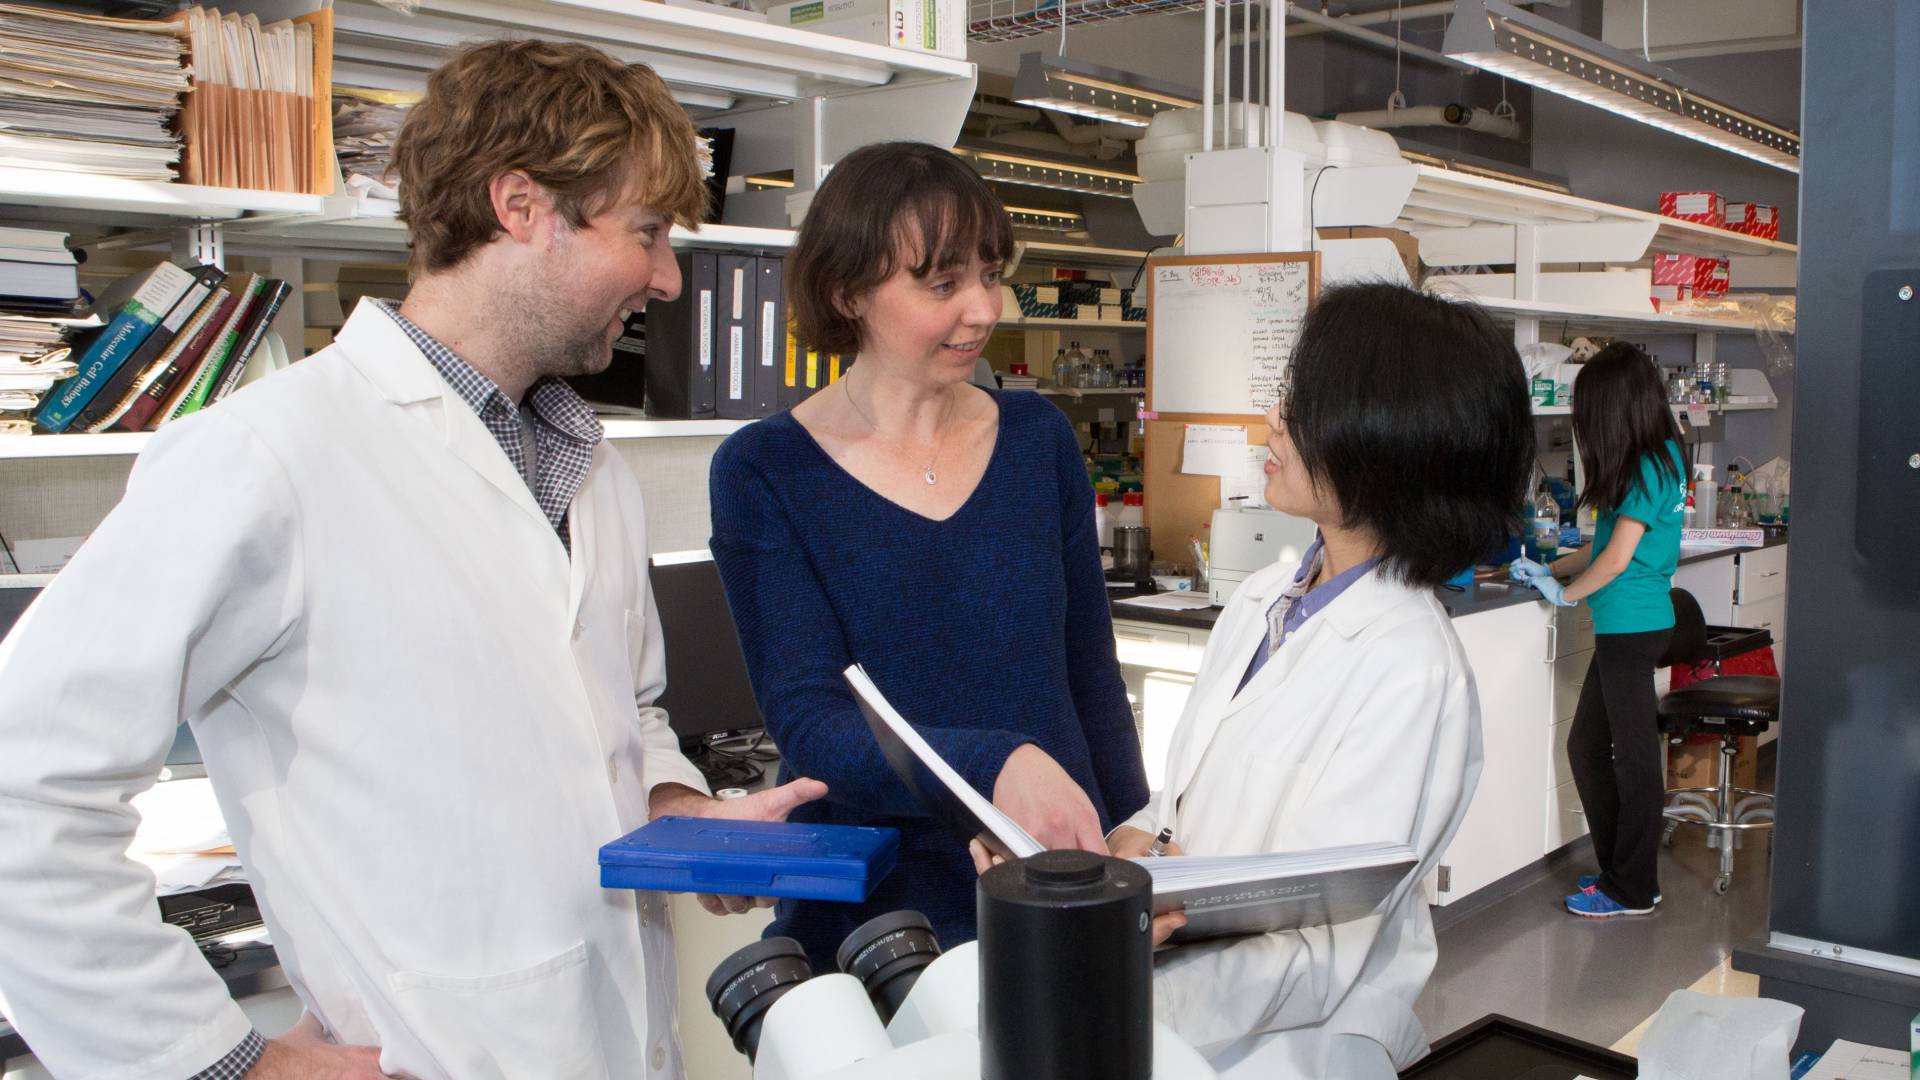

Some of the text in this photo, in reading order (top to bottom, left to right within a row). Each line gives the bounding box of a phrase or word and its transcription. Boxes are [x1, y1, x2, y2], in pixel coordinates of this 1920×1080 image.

[101, 322, 135, 360] Molecular
[86, 361, 104, 379] Cell
[61, 377, 90, 408] Biology
